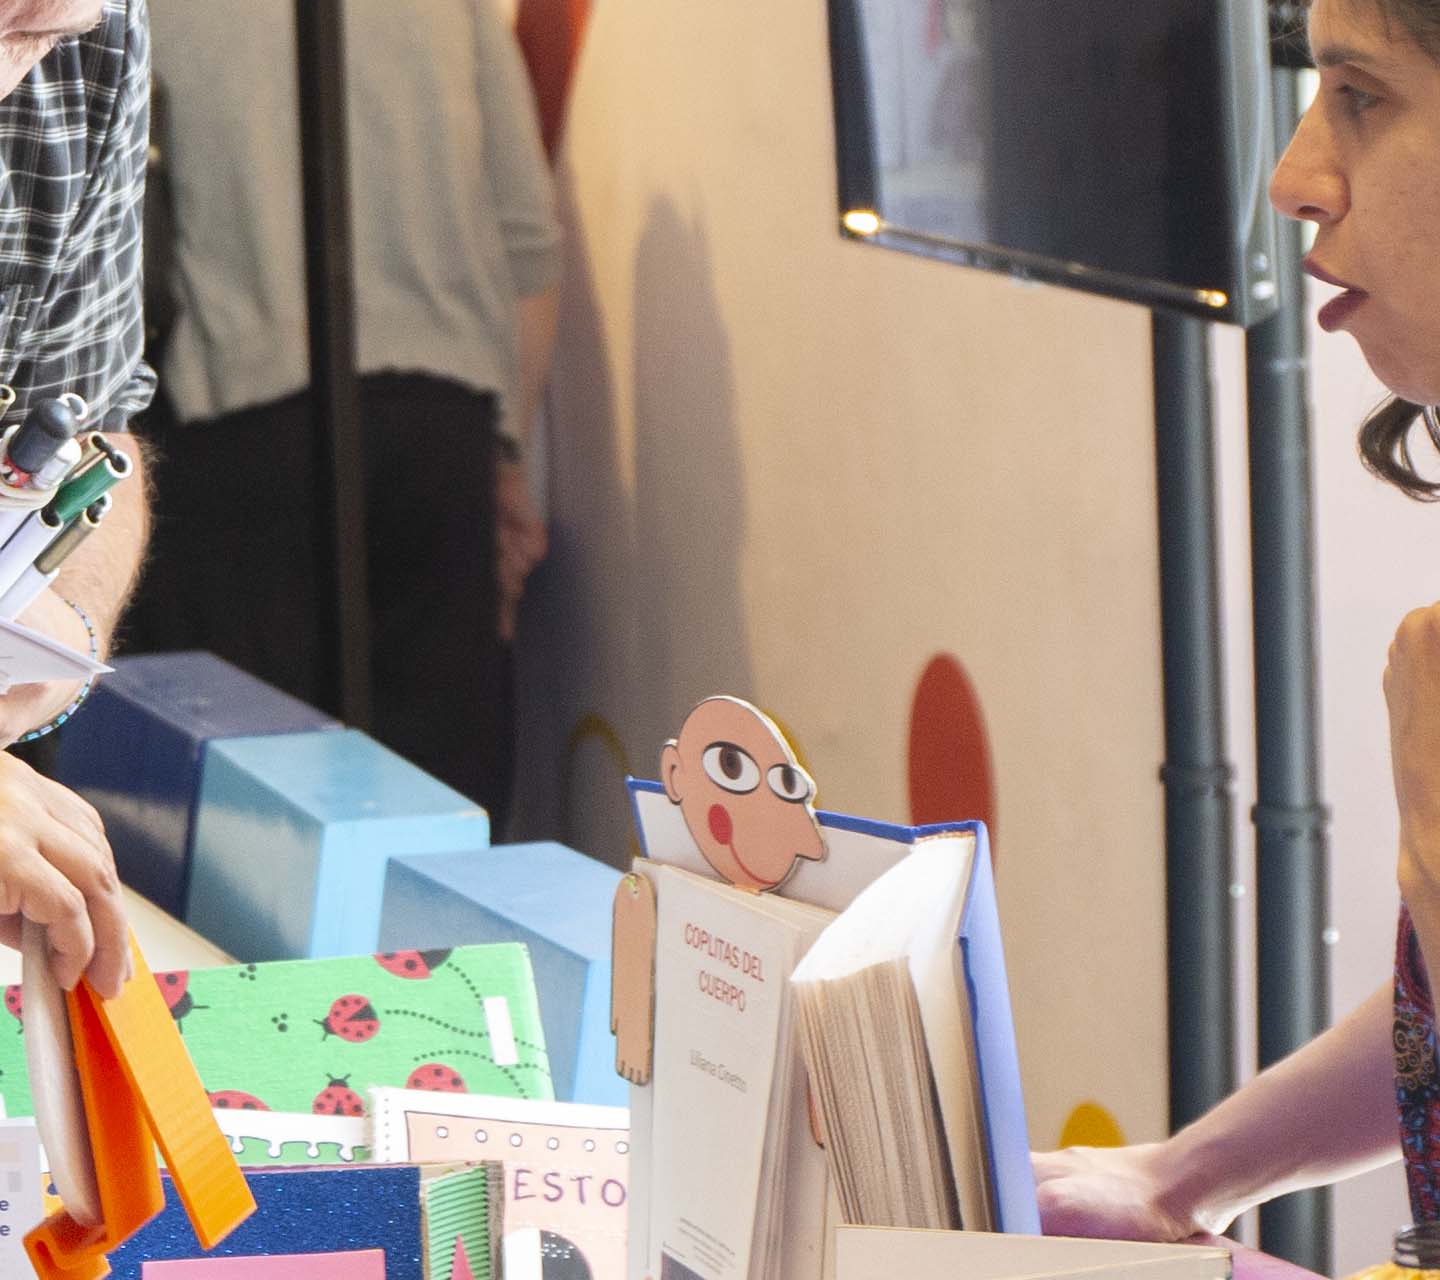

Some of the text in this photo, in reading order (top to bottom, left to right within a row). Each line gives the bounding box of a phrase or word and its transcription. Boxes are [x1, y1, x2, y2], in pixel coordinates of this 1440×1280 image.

[683, 921, 765, 983] COPLITAS DEL
[698, 970, 747, 1013] CUERPO
